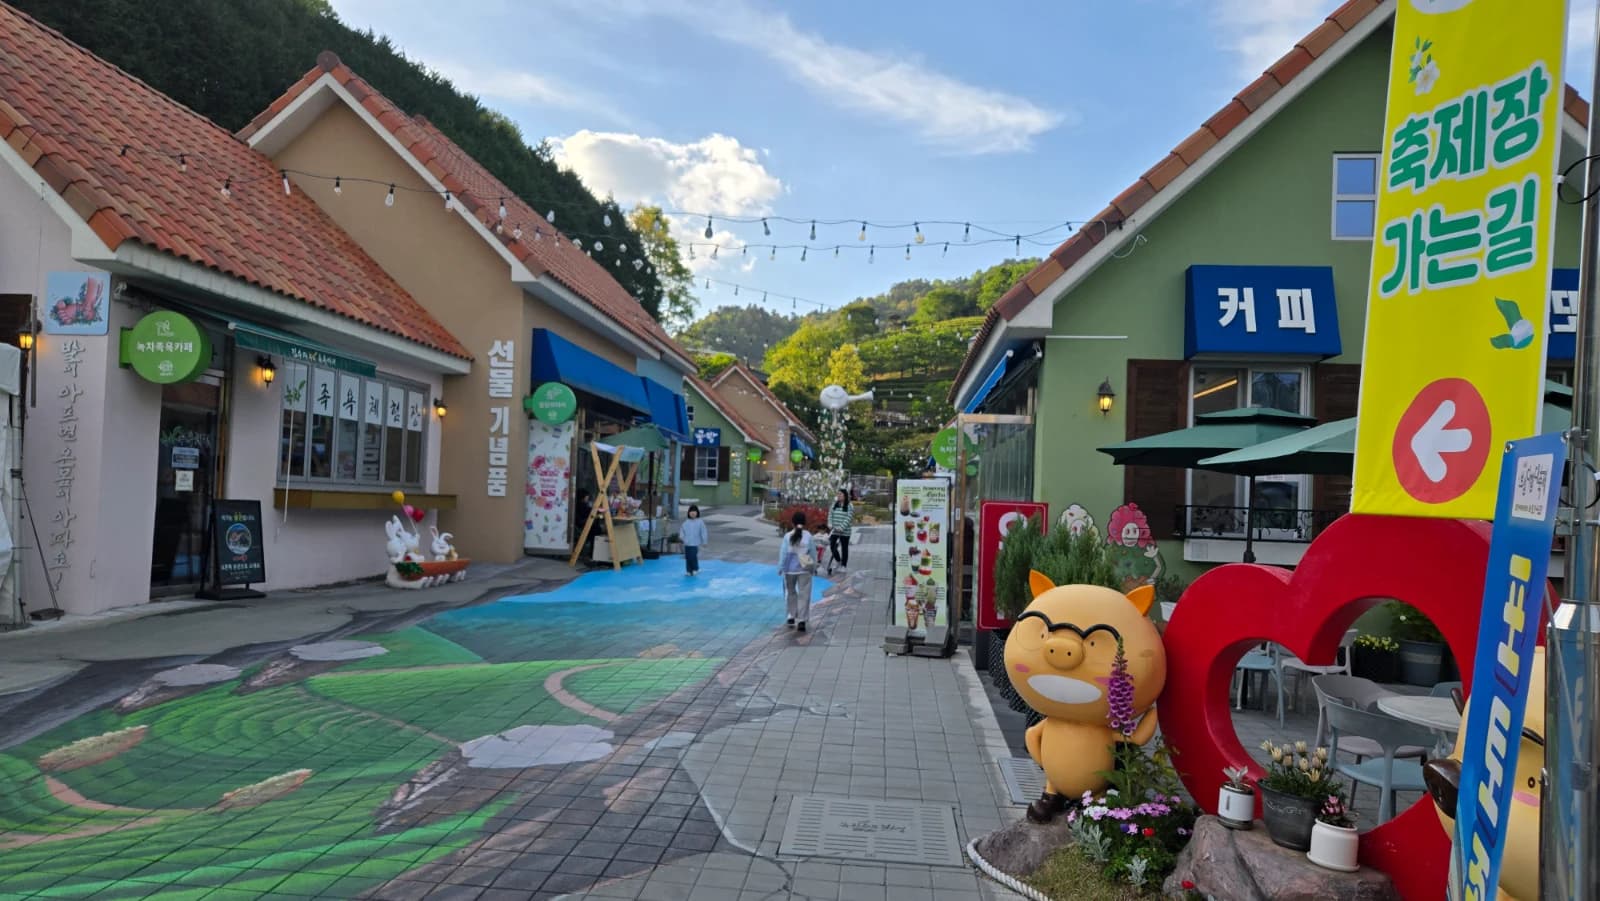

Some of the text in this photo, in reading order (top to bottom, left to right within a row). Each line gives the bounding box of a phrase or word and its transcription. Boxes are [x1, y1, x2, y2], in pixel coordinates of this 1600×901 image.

[1387, 63, 1551, 193] 축제장
[1380, 177, 1538, 294] 가는길
[1216, 286, 1316, 334] 커피
[487, 339, 514, 497] 선물 기념품
